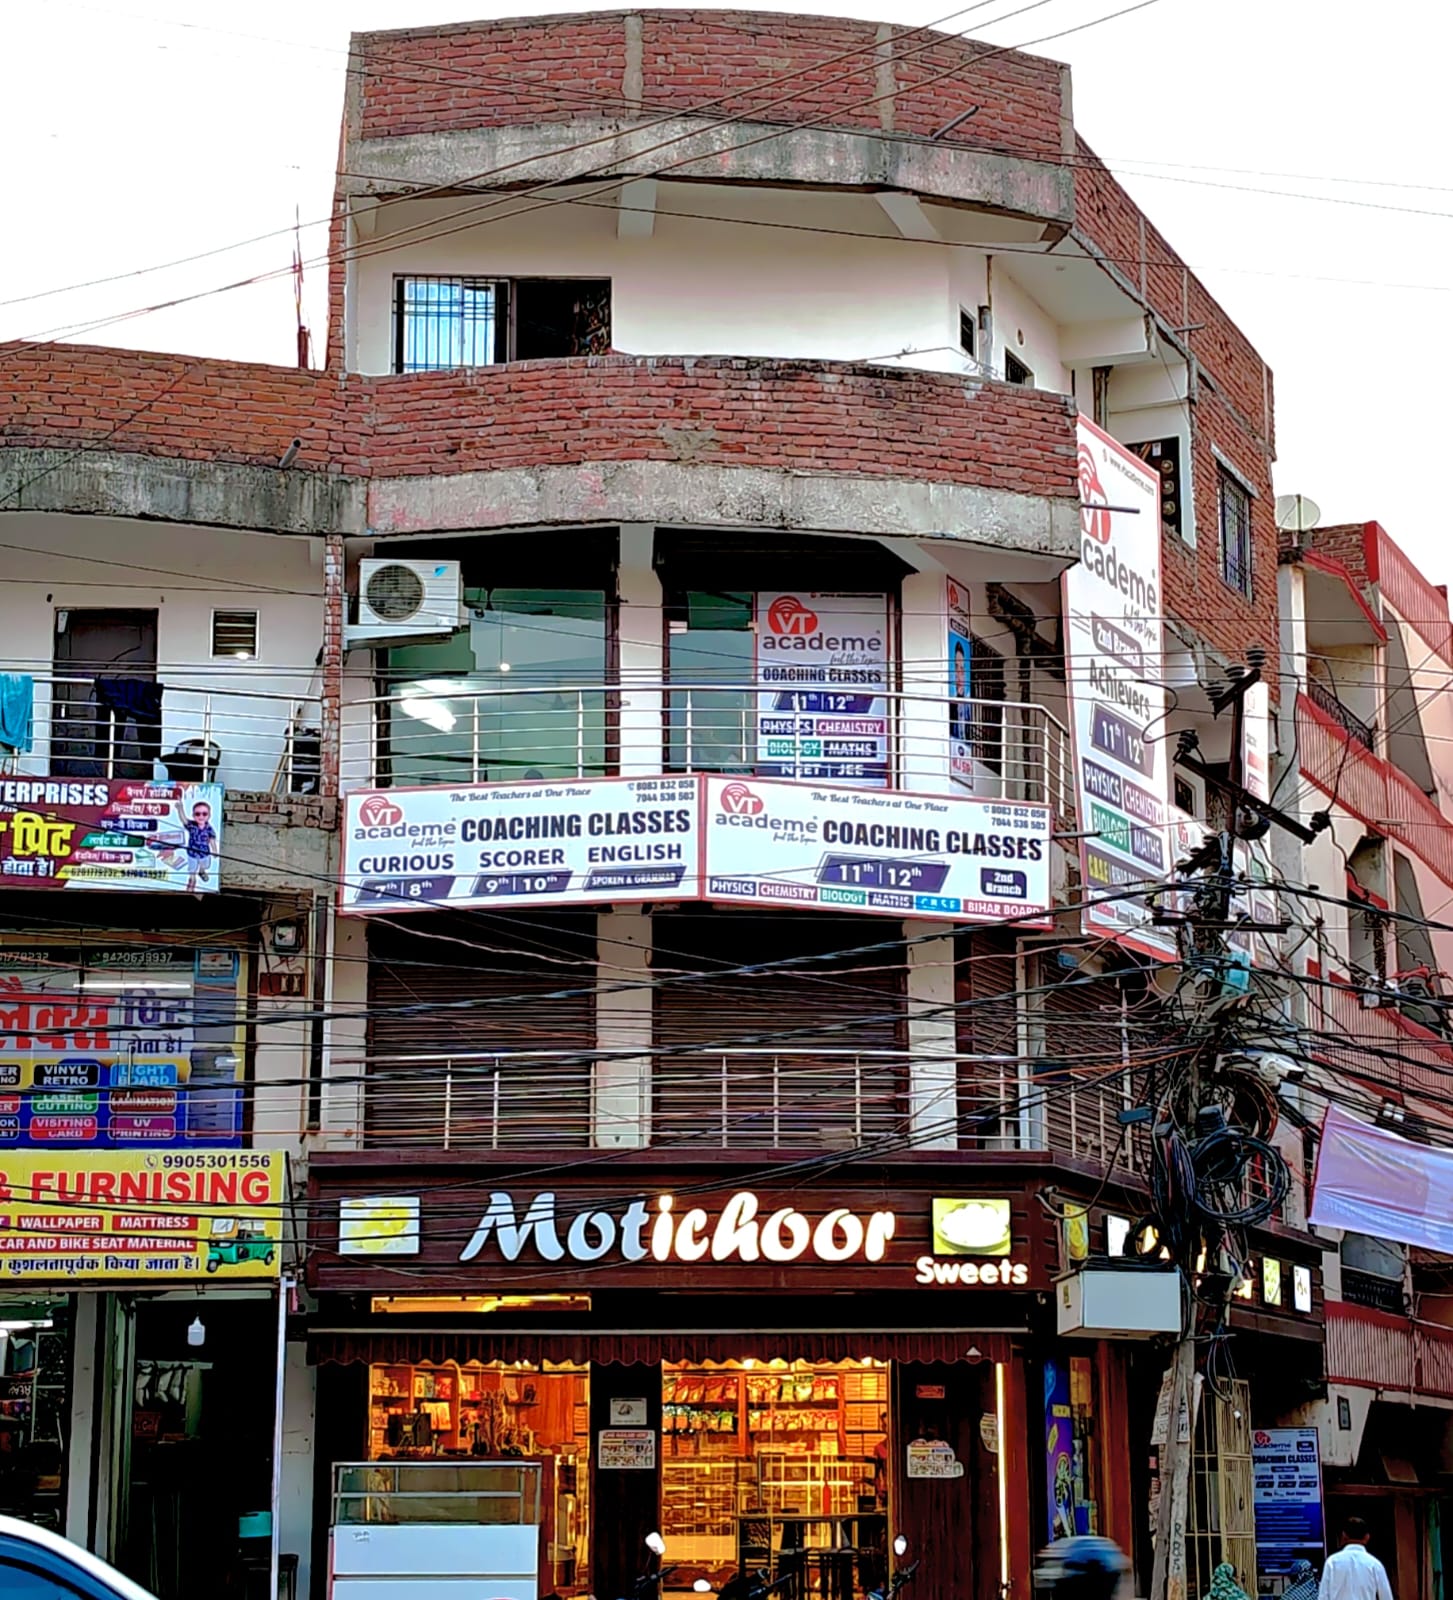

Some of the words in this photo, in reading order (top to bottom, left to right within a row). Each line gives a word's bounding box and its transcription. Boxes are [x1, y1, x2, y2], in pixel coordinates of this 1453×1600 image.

[1083, 538, 1156, 615] cademe
[775, 613, 813, 634] VT
[763, 632, 882, 651] academe
[763, 668, 826, 681] COACHING
[1090, 658, 1150, 721] Achievers
[818, 721, 881, 736] CHEMISTRY
[770, 742, 819, 755] BIOLGY
[1084, 763, 1121, 803] PHYSICS
[450, 792, 466, 802] The
[491, 790, 531, 800] Teachers
[565, 787, 591, 796] Place
[811, 792, 827, 802] The
[852, 796, 891, 807] Teachers
[924, 802, 949, 812] Place
[727, 795, 759, 814] VT
[366, 808, 397, 825] VT
[715, 813, 818, 833] academe
[354, 822, 456, 840] academe
[461, 814, 581, 842] COACHING
[588, 809, 691, 836] CLASSES
[823, 820, 940, 852] COACHING
[946, 830, 1042, 861] CLASSES
[1134, 828, 1161, 864] MATHS
[359, 853, 454, 874] CURIOUS
[479, 848, 565, 868] SCORER
[588, 843, 682, 863] ENGLISH
[592, 876, 624, 886] SPOKEN
[839, 863, 874, 883] 11th
[888, 866, 922, 888] 12th
[994, 871, 1014, 884] 2nd
[409, 880, 433, 896] 8th
[486, 876, 510, 893] 9th
[523, 874, 558, 891] 10th
[986, 882, 1022, 896] Branch
[711, 881, 755, 895] PHYSICS
[760, 885, 816, 899] CHEMISTRY
[821, 890, 864, 904] BIOLOGY
[872, 896, 911, 908] MATHS
[968, 902, 1001, 914] BIHAR
[121, 1065, 167, 1076] LGHT
[43, 1076, 89, 1086] RETRO
[118, 1076, 170, 1087] BOARD
[37, 1102, 94, 1111] CUTTING
[43, 1094, 84, 1103] LASER
[111, 1096, 174, 1107] LAMINATION
[37, 1118, 94, 1128] VISITING
[133, 1118, 151, 1128] UV
[48, 1129, 84, 1138] CARD
[112, 1129, 171, 1137] PRINTING
[163, 1155, 271, 1168] 9905301556
[31, 1171, 270, 1205] FURNISING
[20, 1216, 100, 1229] WALLPAPER
[121, 1216, 190, 1229] MATTRESS
[459, 1191, 896, 1262] Motichoor
[0, 1238, 24, 1250] CAR
[26, 1238, 57, 1250] AND
[60, 1238, 90, 1250] BIKE
[93, 1237, 126, 1250] SEAT
[127, 1237, 194, 1249] MATERIAL
[104, 1255, 140, 1271] किया
[145, 1258, 179, 1271] जाता
[915, 1257, 1029, 1285] Sweets
